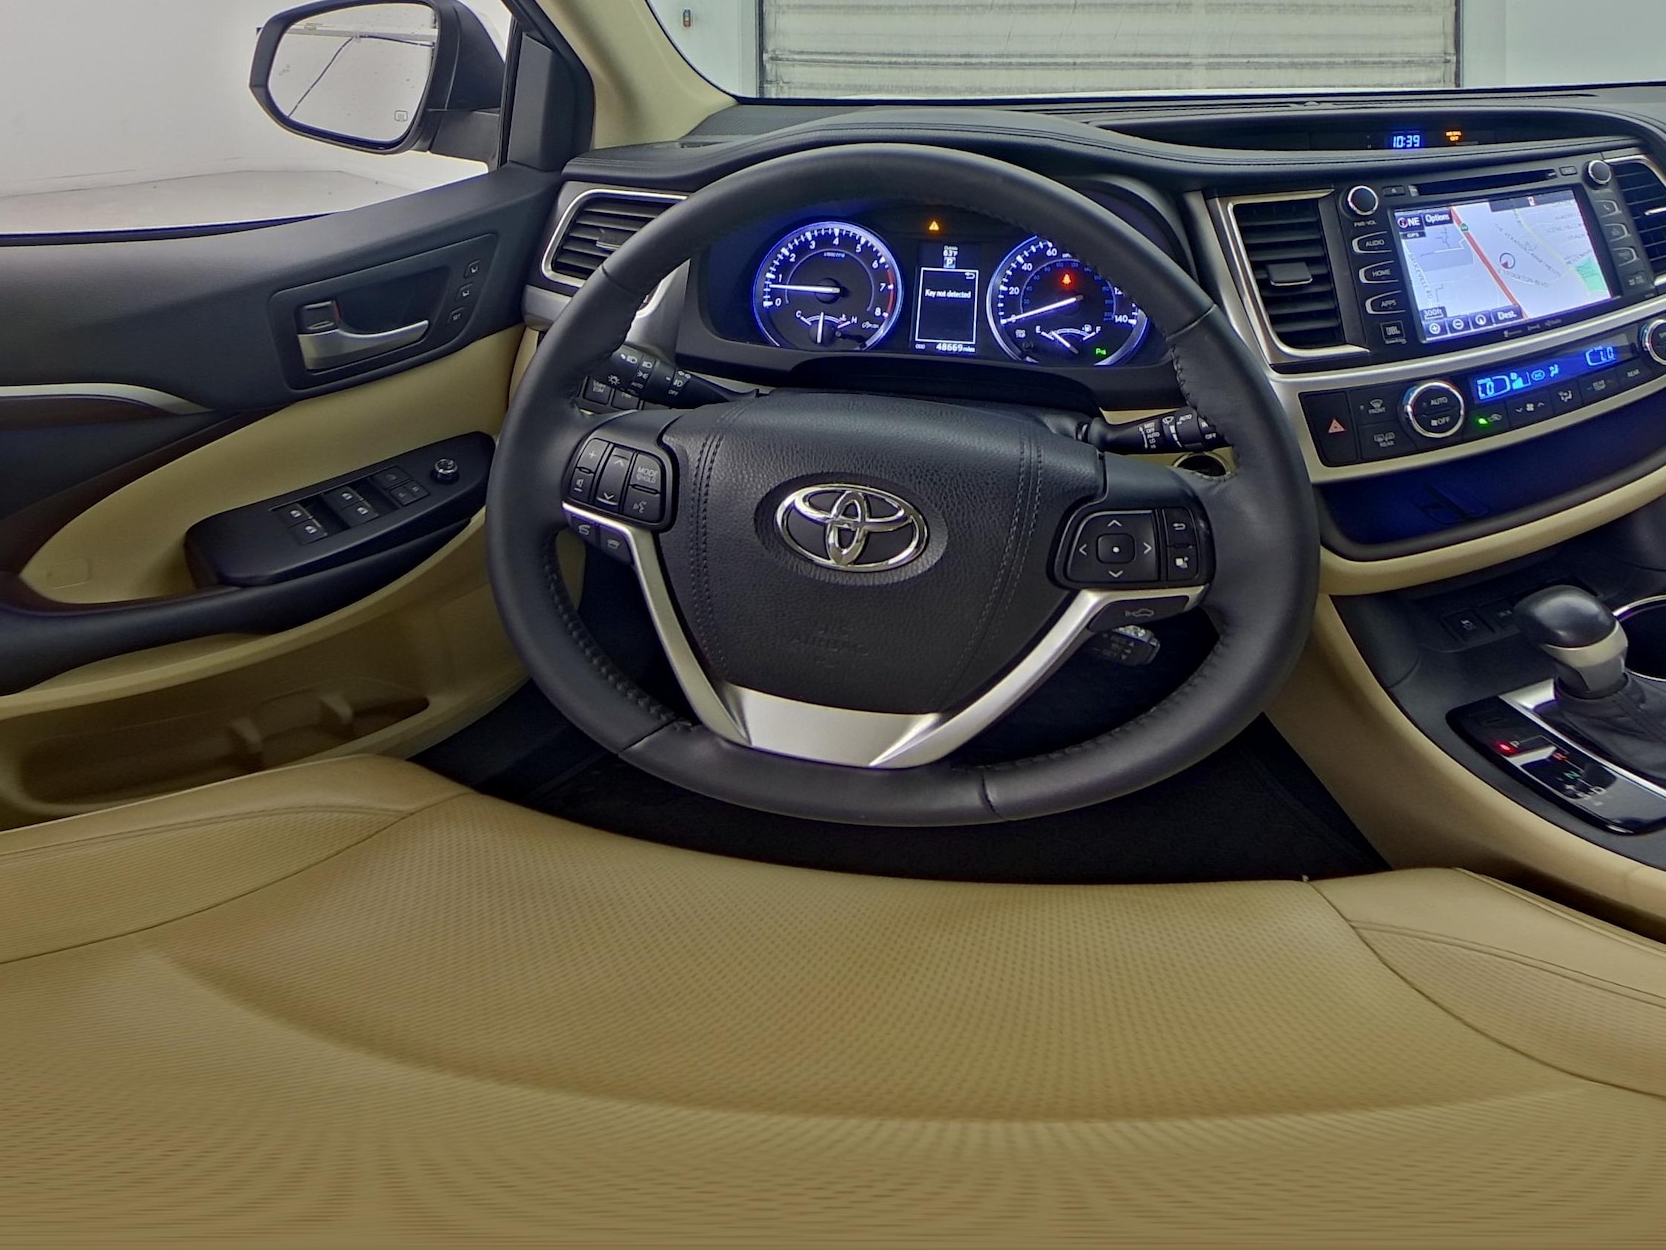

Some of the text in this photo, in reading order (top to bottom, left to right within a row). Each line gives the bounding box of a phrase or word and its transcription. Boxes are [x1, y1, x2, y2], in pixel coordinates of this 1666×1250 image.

[1393, 135, 1420, 148] 10:39
[1408, 217, 1420, 226] NE
[1425, 213, 1450, 223] Options
[810, 241, 815, 249] 3
[1365, 239, 1385, 247] AUDIO
[1046, 248, 1057, 257] 60
[789, 254, 796, 262] 2
[873, 260, 878, 268] 6
[1022, 263, 1033, 271] 40
[1371, 269, 1391, 277] HOME
[779, 274, 782, 282] 1
[880, 283, 886, 291] 7
[1009, 287, 1020, 295] 20
[925, 289, 936, 298] Key
[947, 290, 971, 298] detected
[775, 298, 781, 306] 0
[875, 308, 881, 316] 8
[1115, 315, 1128, 323] 140
[936, 343, 963, 351] 48669
[1430, 397, 1448, 405] AUTO
[1437, 417, 1450, 425] OFF
[637, 466, 658, 477] MODE
[1564, 770, 1581, 779] N
